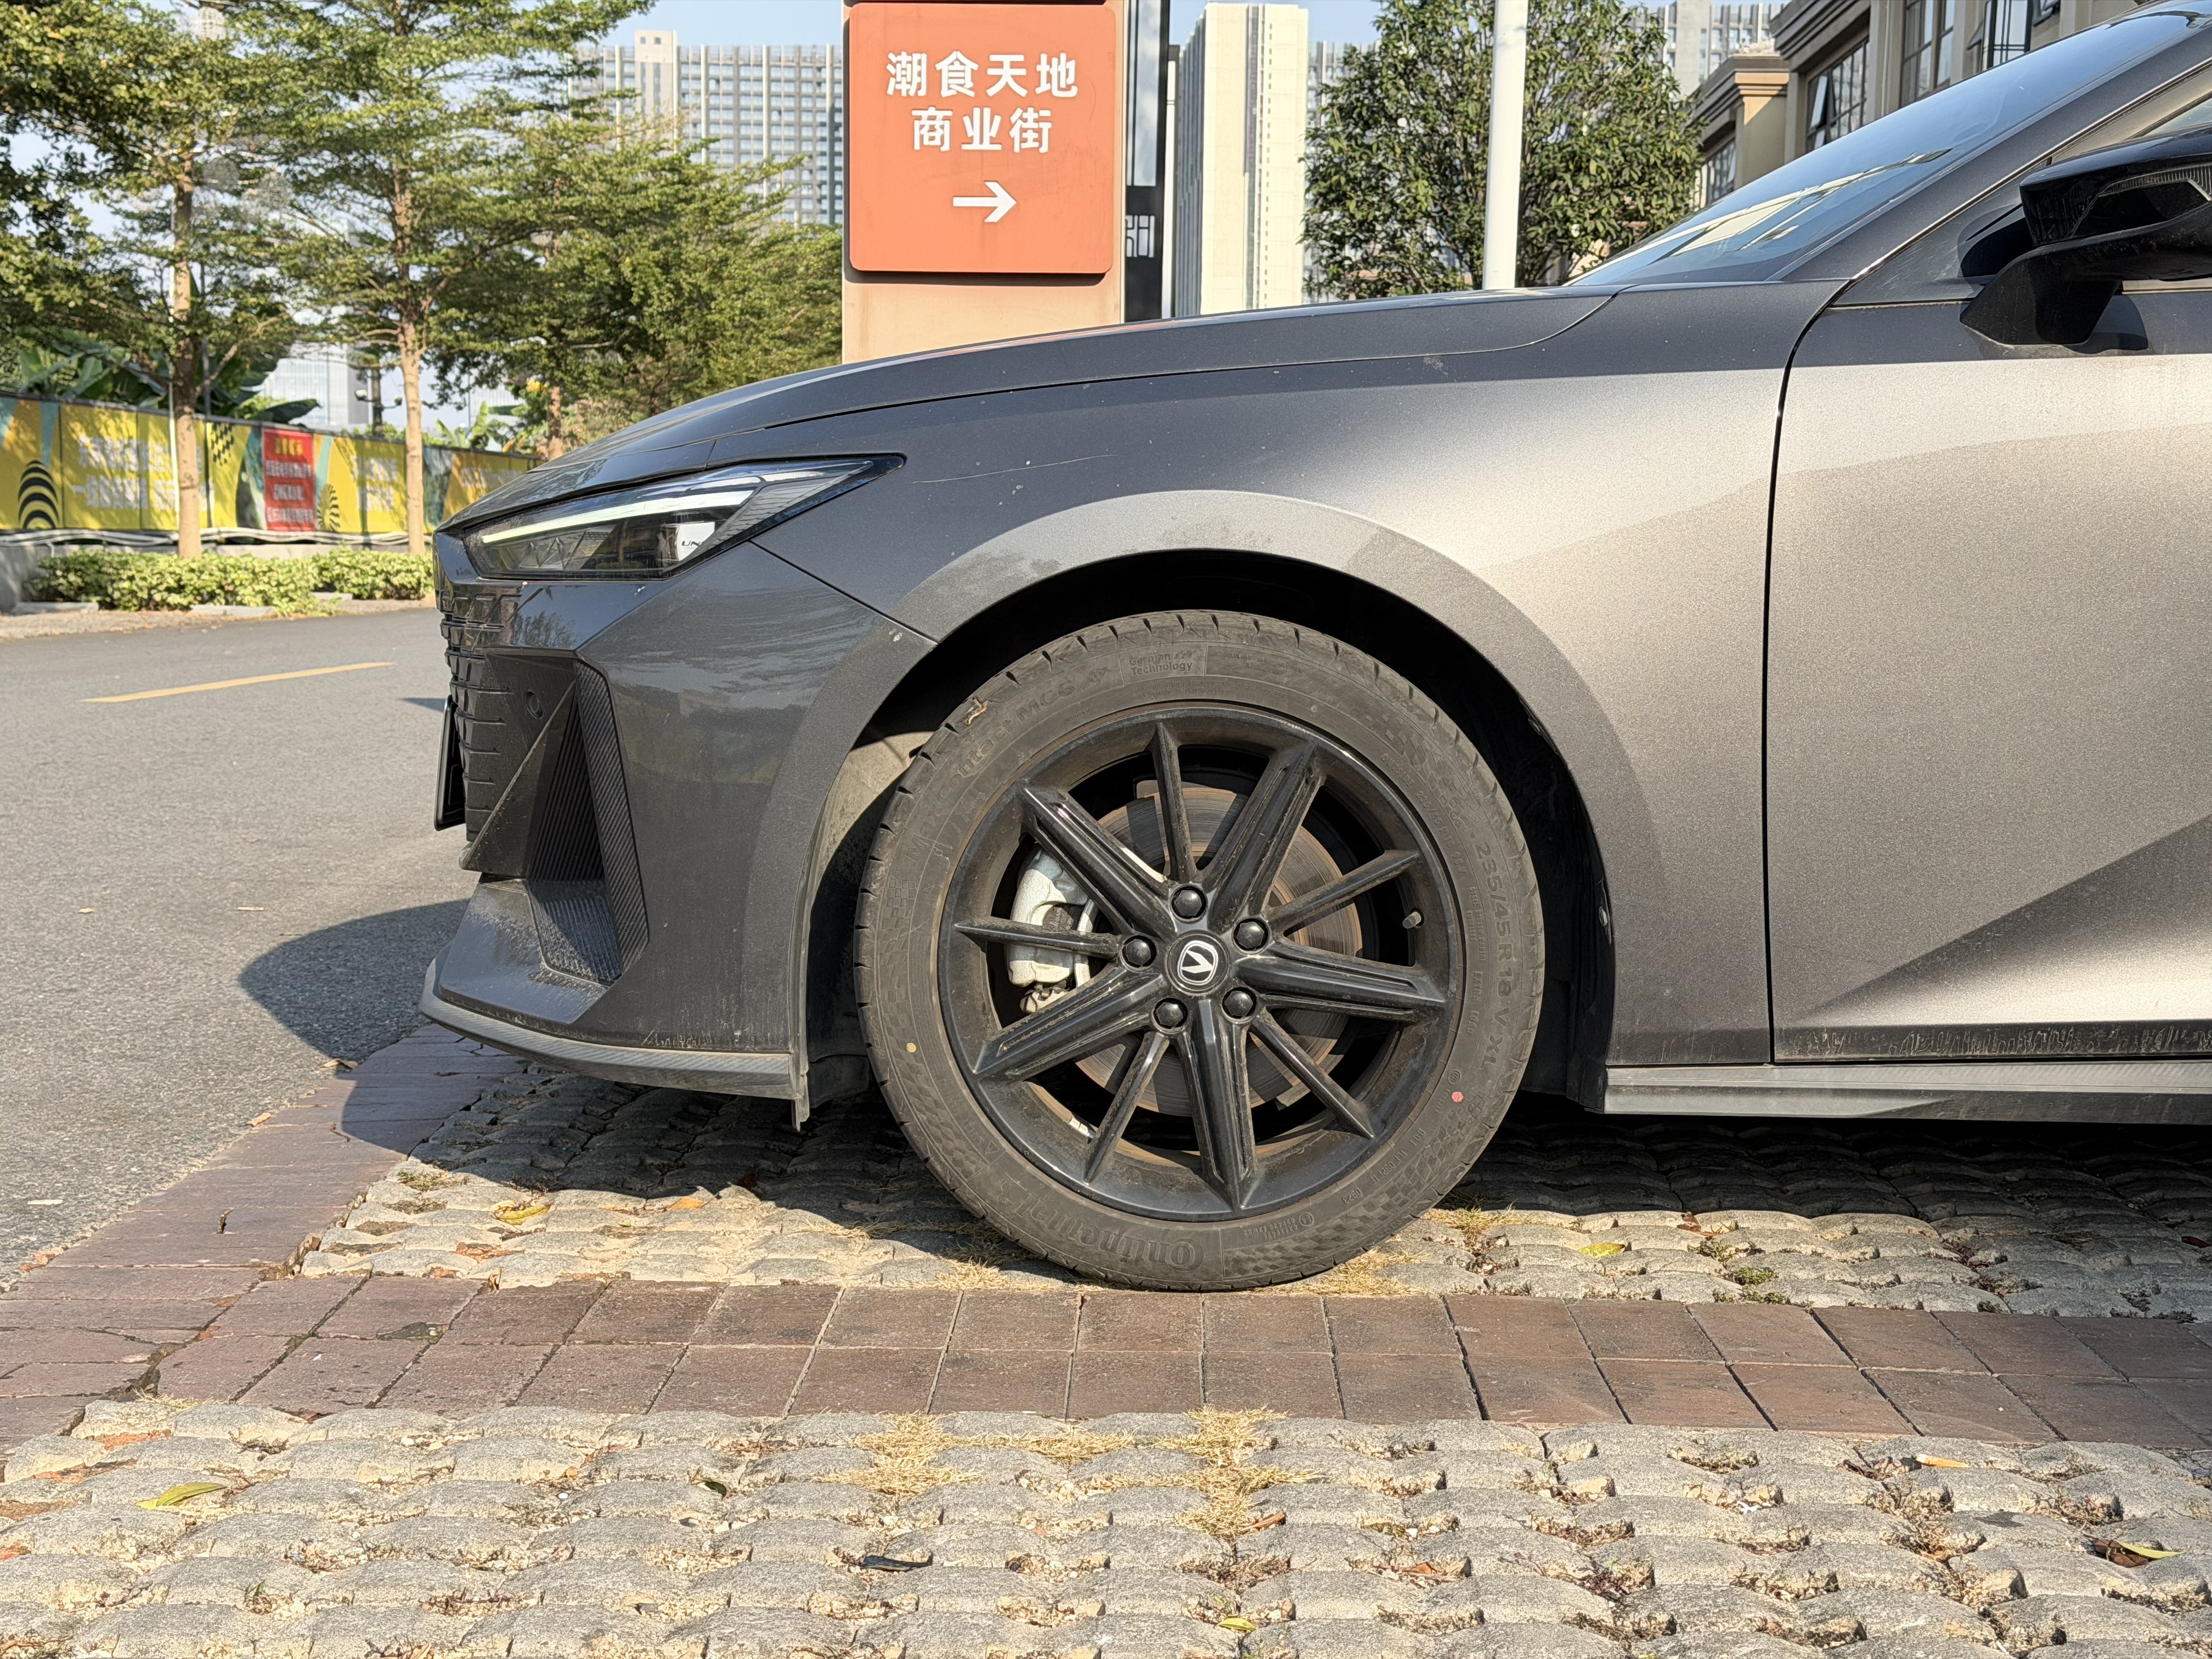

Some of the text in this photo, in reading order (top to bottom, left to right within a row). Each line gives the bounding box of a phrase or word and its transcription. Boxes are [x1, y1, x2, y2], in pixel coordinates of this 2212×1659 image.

[886, 50, 1079, 98] 潮食天地
[911, 106, 1052, 153] 商业街
[1128, 651, 1171, 667] German
[1130, 660, 1192, 678] Technology
[904, 715, 1016, 861] MaxContact
[1014, 678, 1077, 724] MC6
[1474, 839, 1511, 936] 235/45
[1465, 970, 1483, 1036] EXTRA LOAD
[1491, 1005, 1509, 1026] V
[1478, 1034, 1503, 1074] XL
[1013, 1189, 1204, 1273] Continental
